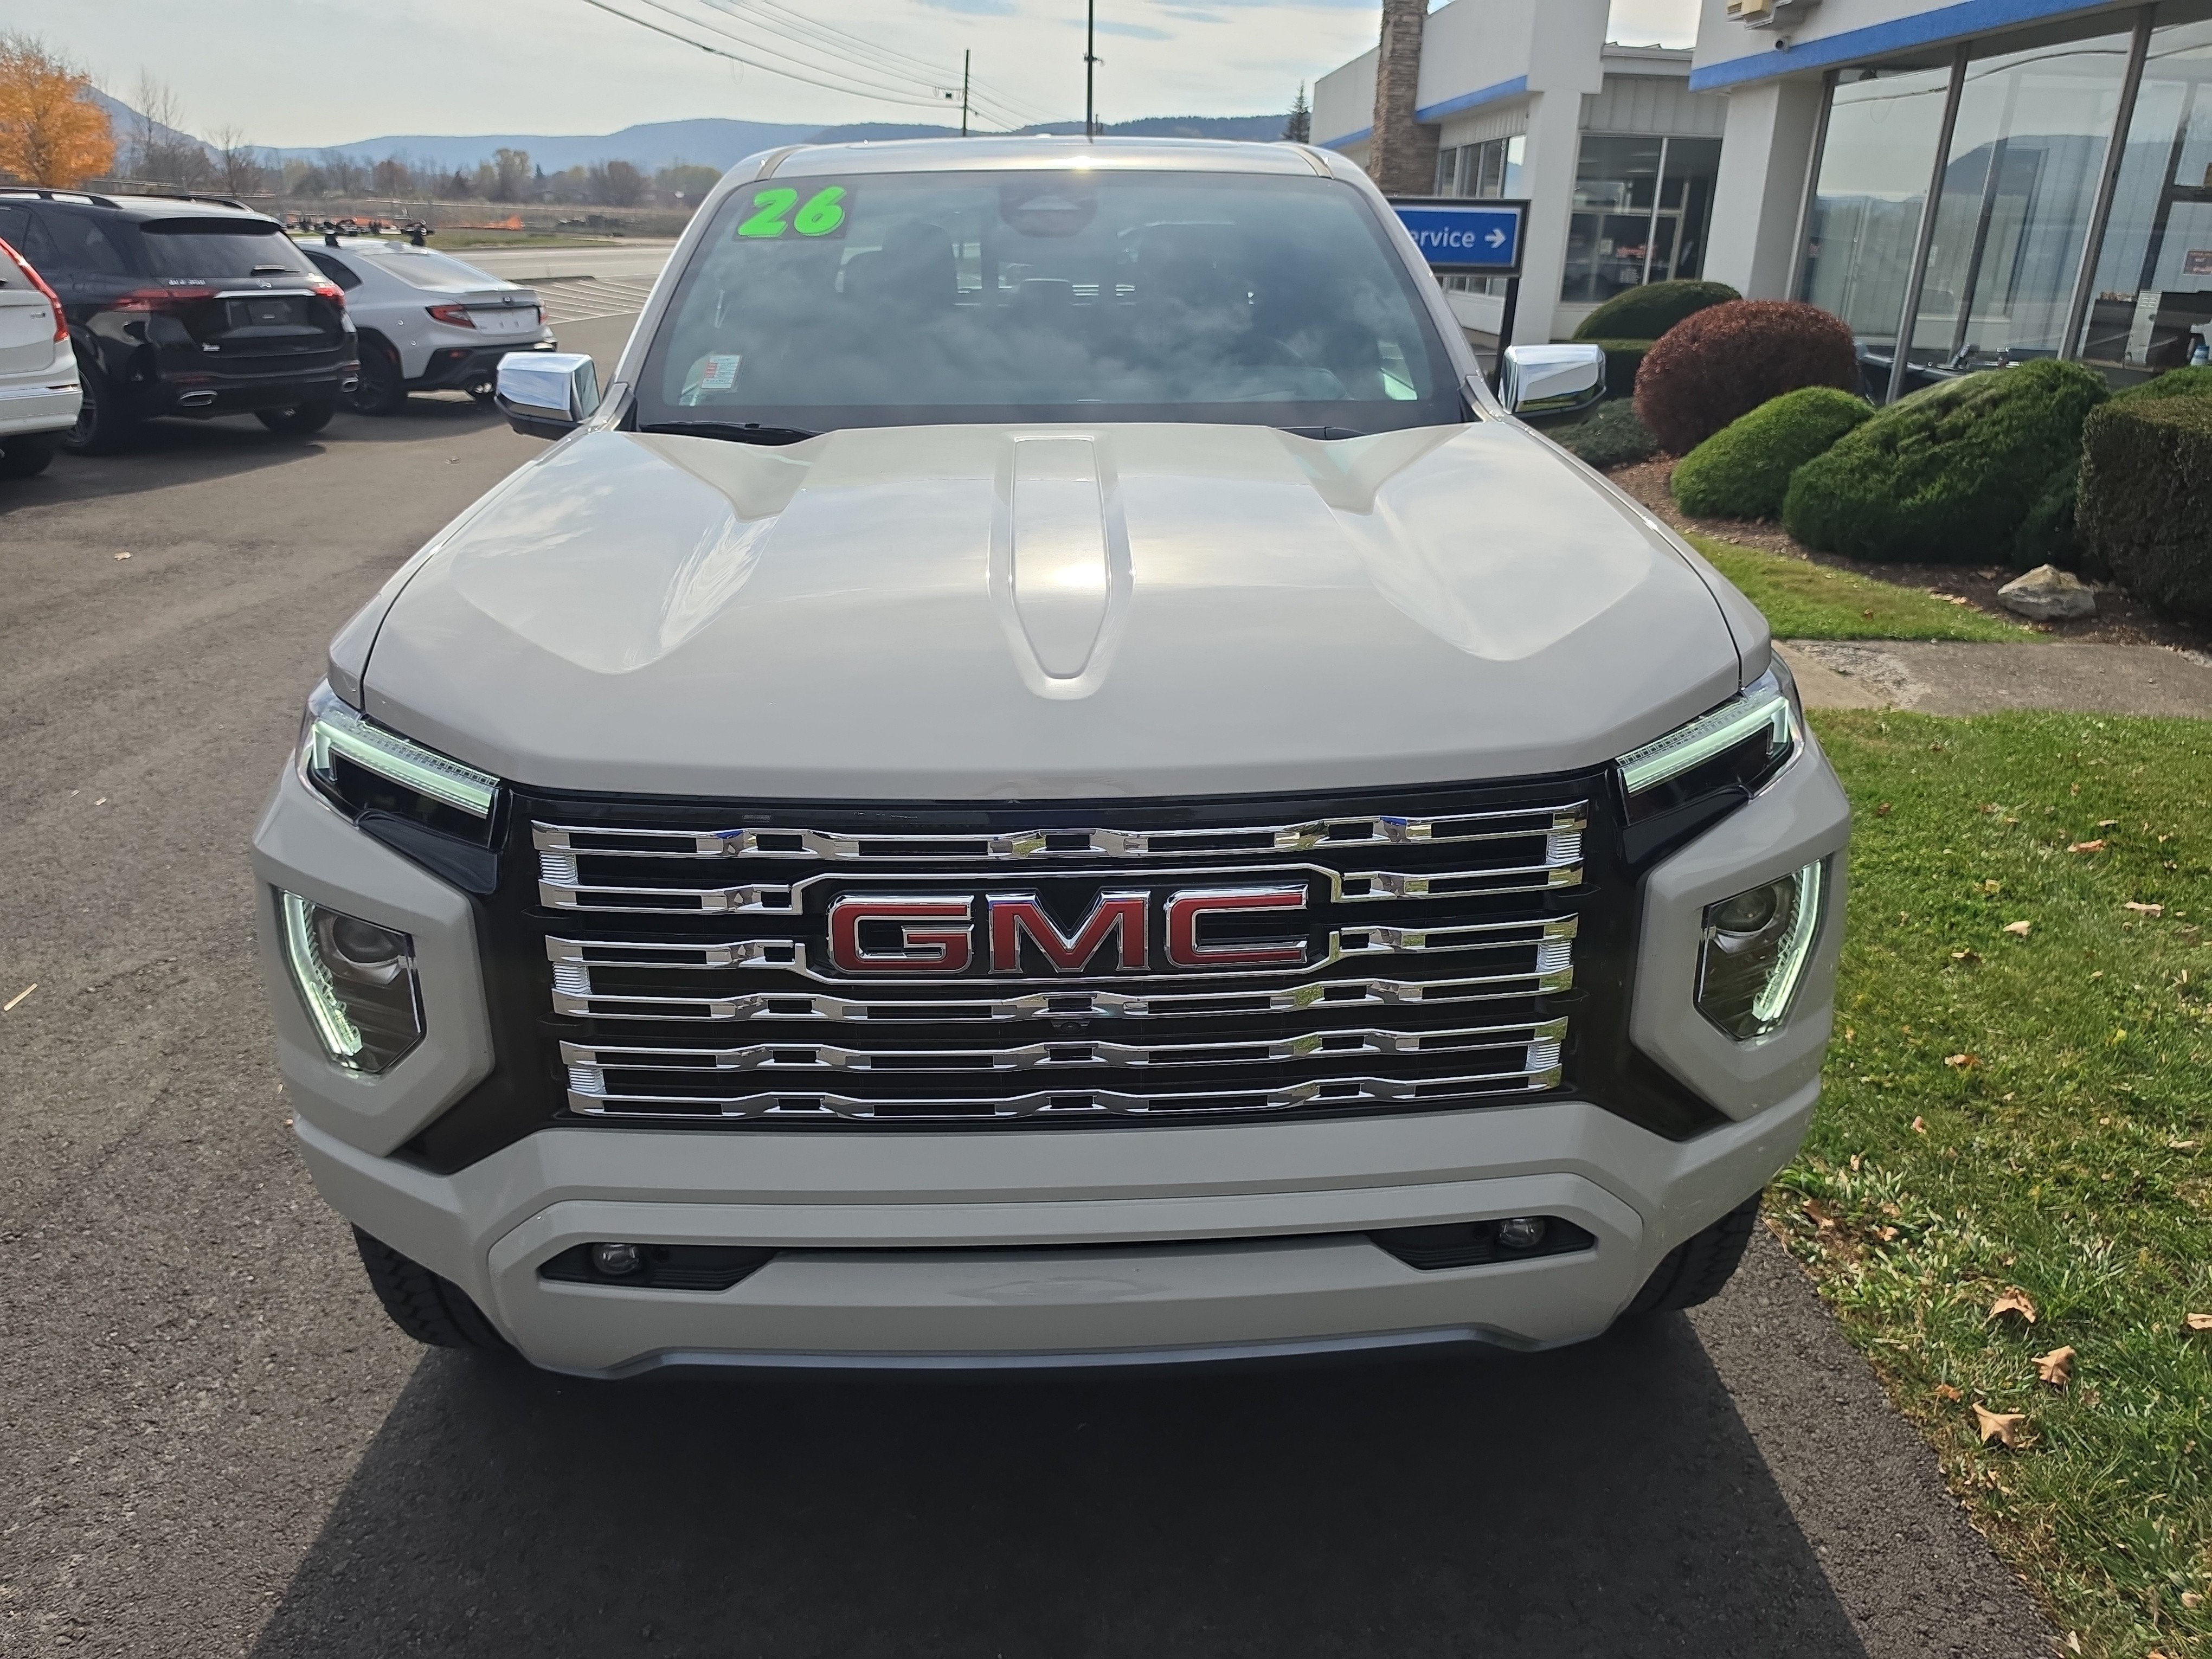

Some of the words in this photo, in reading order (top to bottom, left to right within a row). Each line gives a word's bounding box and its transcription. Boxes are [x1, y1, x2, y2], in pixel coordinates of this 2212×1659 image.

[737, 186, 847, 238] 26
[1410, 226, 1475, 248] ervice
[827, 884, 1308, 974] GMC
